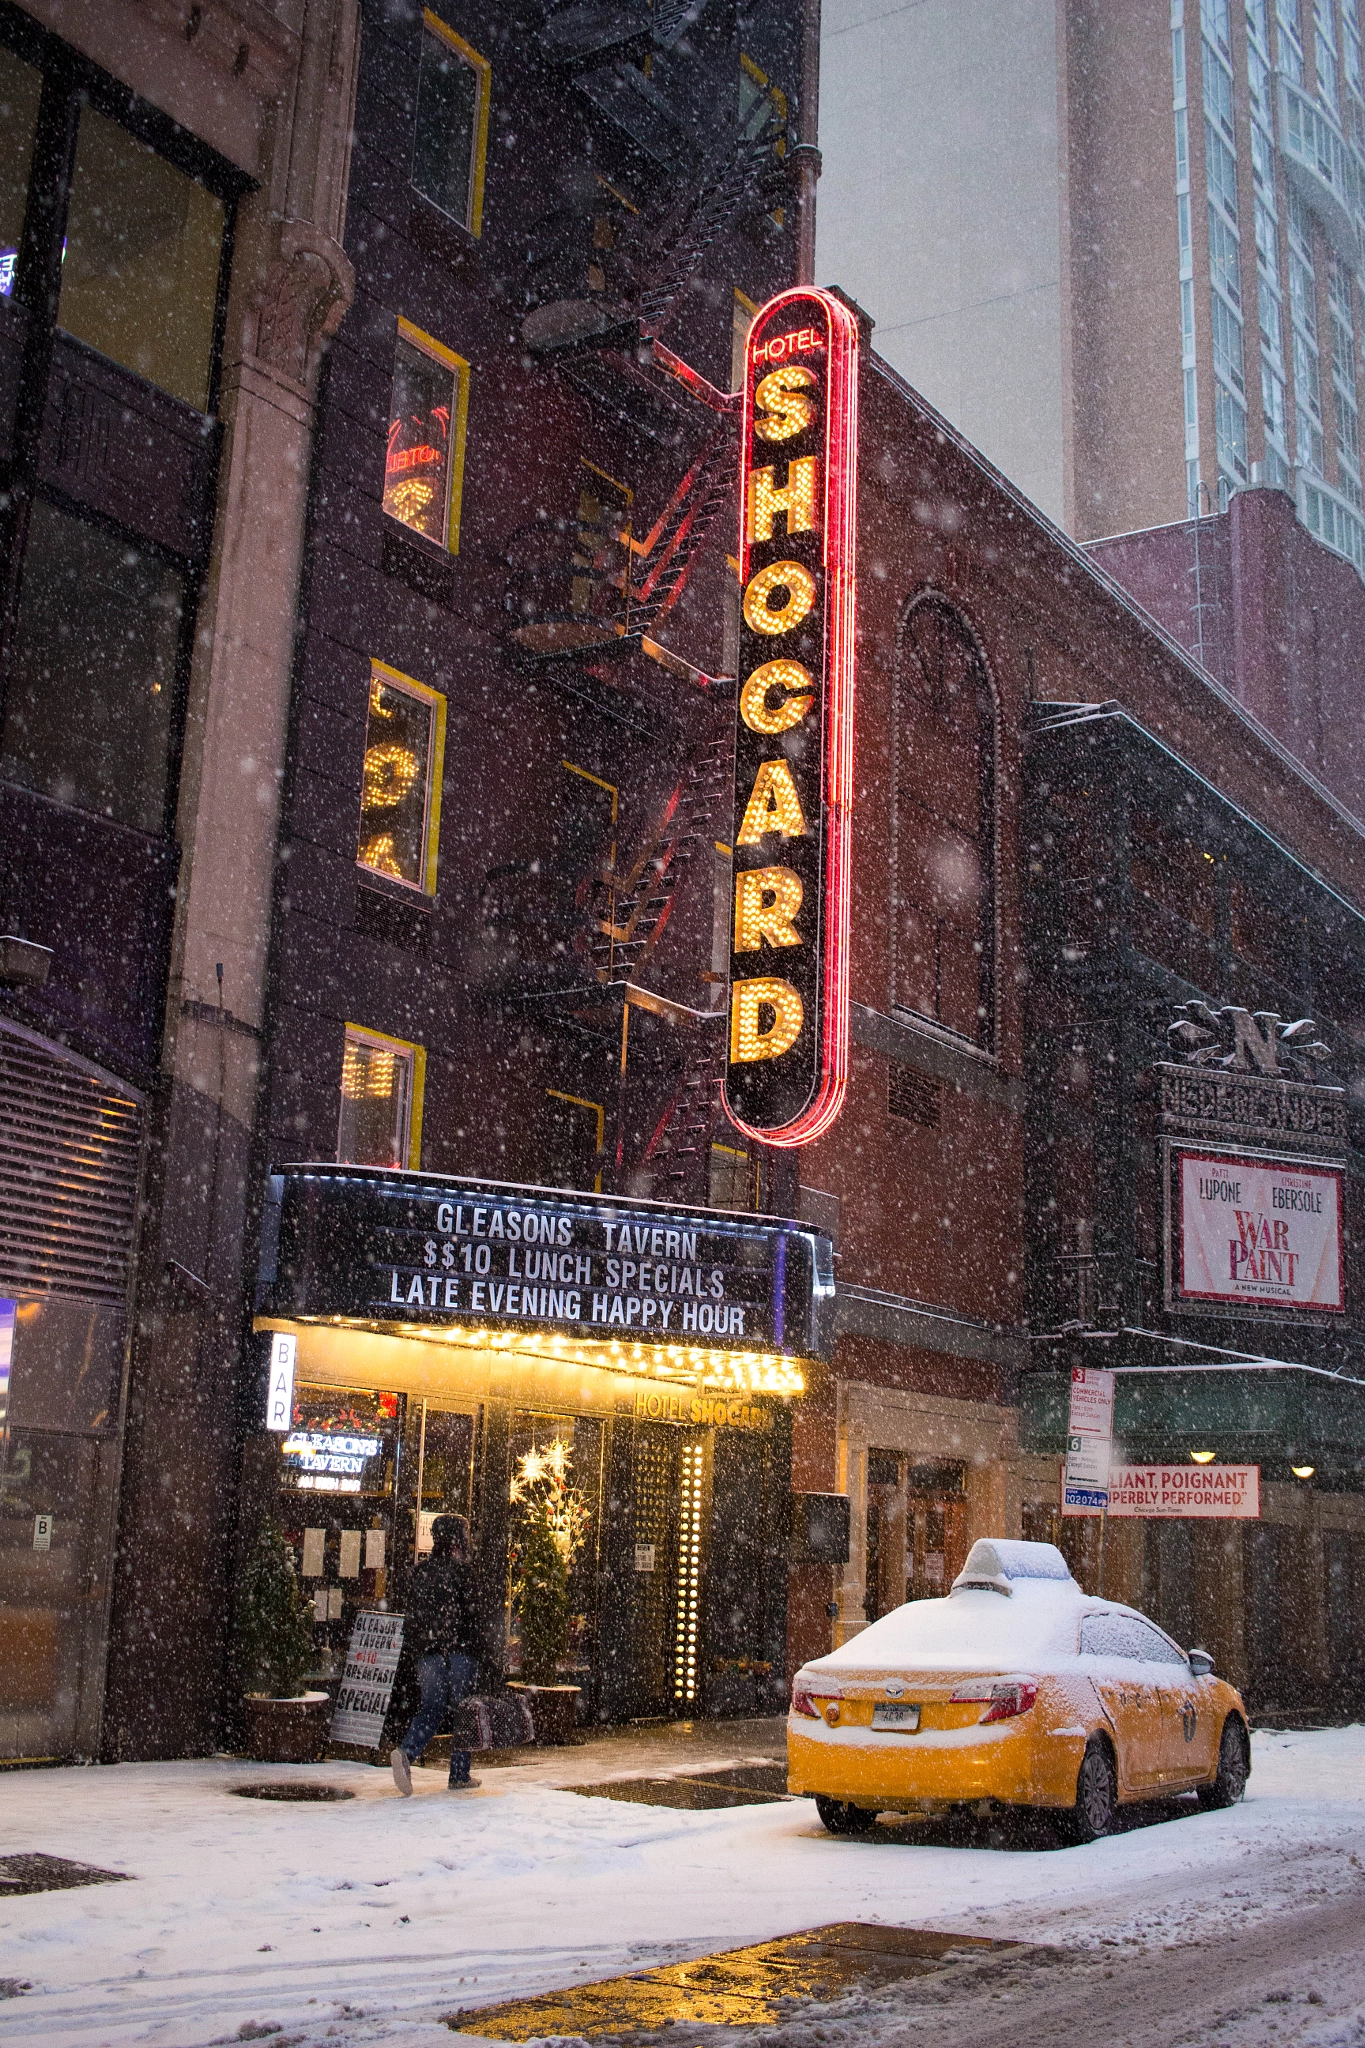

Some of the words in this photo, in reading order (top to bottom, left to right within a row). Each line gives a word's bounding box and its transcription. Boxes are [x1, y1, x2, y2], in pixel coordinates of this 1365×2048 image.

[753, 328, 823, 363] HOTEL
[730, 366, 818, 1064] SHOCARD
[1161, 1077, 1348, 1137] NEDERLANDER
[1281, 1177, 1312, 1189] CHRISTINE
[1199, 1178, 1242, 1203] LUPONE
[1272, 1187, 1322, 1214] EBERSOLE
[437, 1203, 571, 1247] GLEASONS
[602, 1222, 697, 1261] TAVERN
[1232, 1209, 1290, 1251] WAR
[423, 1240, 491, 1275] $$10
[508, 1248, 591, 1285] LUNCH
[605, 1258, 725, 1299] SPECIALS
[1228, 1239, 1299, 1286] PAINT
[1259, 1286, 1292, 1296] MUSICAL
[390, 1271, 458, 1308] LATE
[471, 1281, 581, 1320] EVENING
[592, 1290, 674, 1329] HAPPY
[683, 1301, 744, 1335] HOUR
[273, 1342, 290, 1423] BAR
[1075, 1368, 1084, 1382] 3
[1072, 1387, 1106, 1397] COMMERCIAL
[1072, 1395, 1097, 1404] VEHICLES
[635, 1392, 685, 1420] HOTEL
[691, 1399, 772, 1428] SHOCARD
[550, 1439, 569, 1451] 26
[1071, 1437, 1079, 1451] 6
[300, 1454, 364, 1473] TAVERN
[1109, 1472, 1158, 1490] LIANT,
[1161, 1472, 1248, 1489] POIGNANT
[1066, 1494, 1098, 1506] 102074
[1109, 1491, 1159, 1505] PERBLY
[38, 1520, 48, 1535] B
[359, 1634, 393, 1650] TAVERN
[346, 1664, 396, 1684] BREAKFAST
[337, 1688, 388, 1716] SPECIAL
